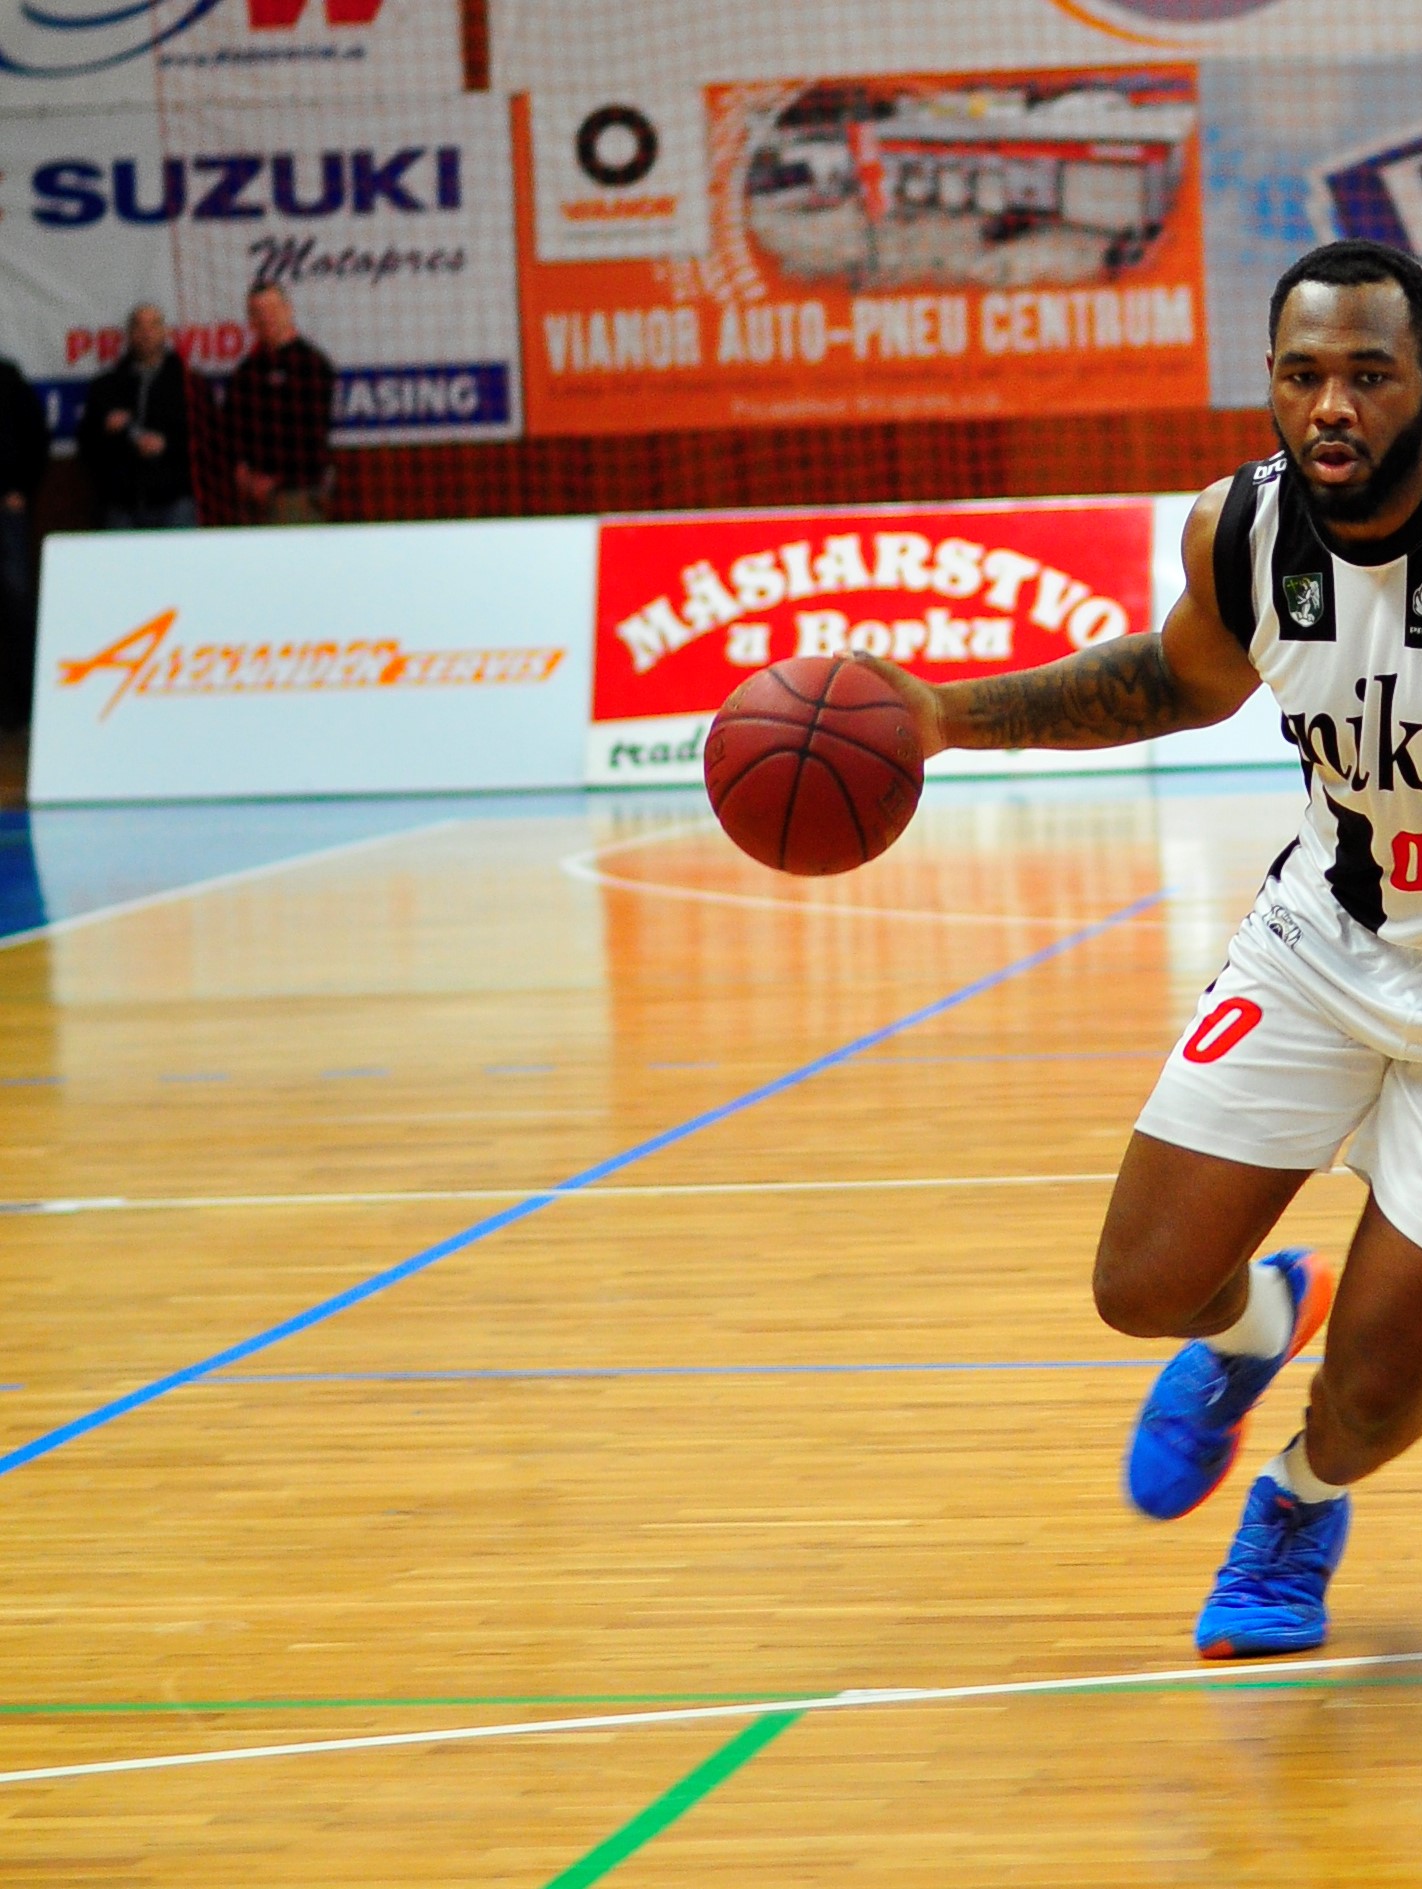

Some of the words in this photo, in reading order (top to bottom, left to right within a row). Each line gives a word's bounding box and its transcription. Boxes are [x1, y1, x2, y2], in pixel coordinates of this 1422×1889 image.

[31, 146, 463, 228] SUZUKI
[248, 235, 467, 284] Motopres
[544, 308, 700, 374] VIANOR
[717, 297, 969, 365] AUTO-PNEU
[980, 286, 1194, 358] CENTRUM
[1253, 457, 1287, 480] bro
[616, 531, 1130, 674] MÄSIARSTVO
[798, 606, 1015, 663] Borku
[609, 722, 704, 769] trad
[1182, 996, 1263, 1064] 0
